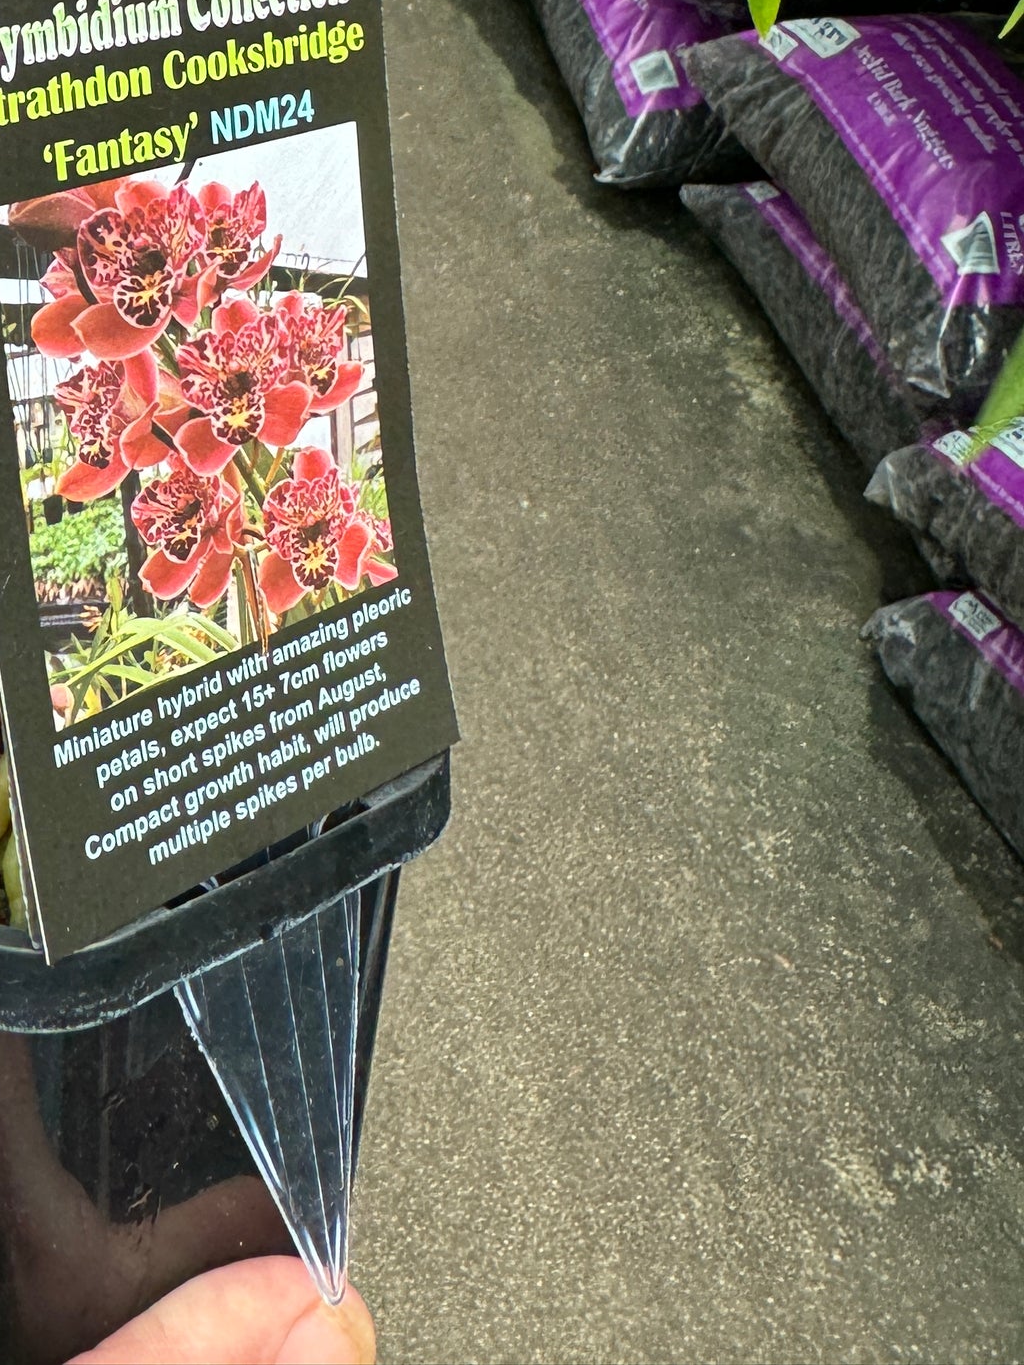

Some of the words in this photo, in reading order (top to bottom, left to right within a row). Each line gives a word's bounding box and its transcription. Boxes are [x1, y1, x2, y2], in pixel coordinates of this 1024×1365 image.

[162, 19, 365, 91] Cooksbridge
[210, 88, 315, 145] NDM24
[53, 708, 154, 768] Miniature
[157, 670, 223, 719] hybrid
[225, 651, 269, 686] with
[271, 620, 350, 667] amazing
[352, 586, 413, 637] pleoric
[95, 739, 167, 789] petals,
[170, 697, 238, 749] expect
[241, 684, 277, 714] 15+
[278, 662, 320, 696] 7cm
[322, 629, 389, 675] flowers
[108, 783, 140, 813] on
[142, 754, 199, 799] short
[201, 723, 267, 774] spikes
[269, 696, 315, 735] from
[317, 662, 388, 714] August,
[83, 805, 181, 862] Compact
[184, 761, 255, 817] growth
[257, 737, 312, 781] habit,
[313, 714, 347, 745] will
[347, 676, 422, 732] produce
[147, 808, 232, 866] multiple
[234, 777, 299, 824] spikes
[301, 757, 333, 790] per
[334, 731, 382, 767] bulb.
